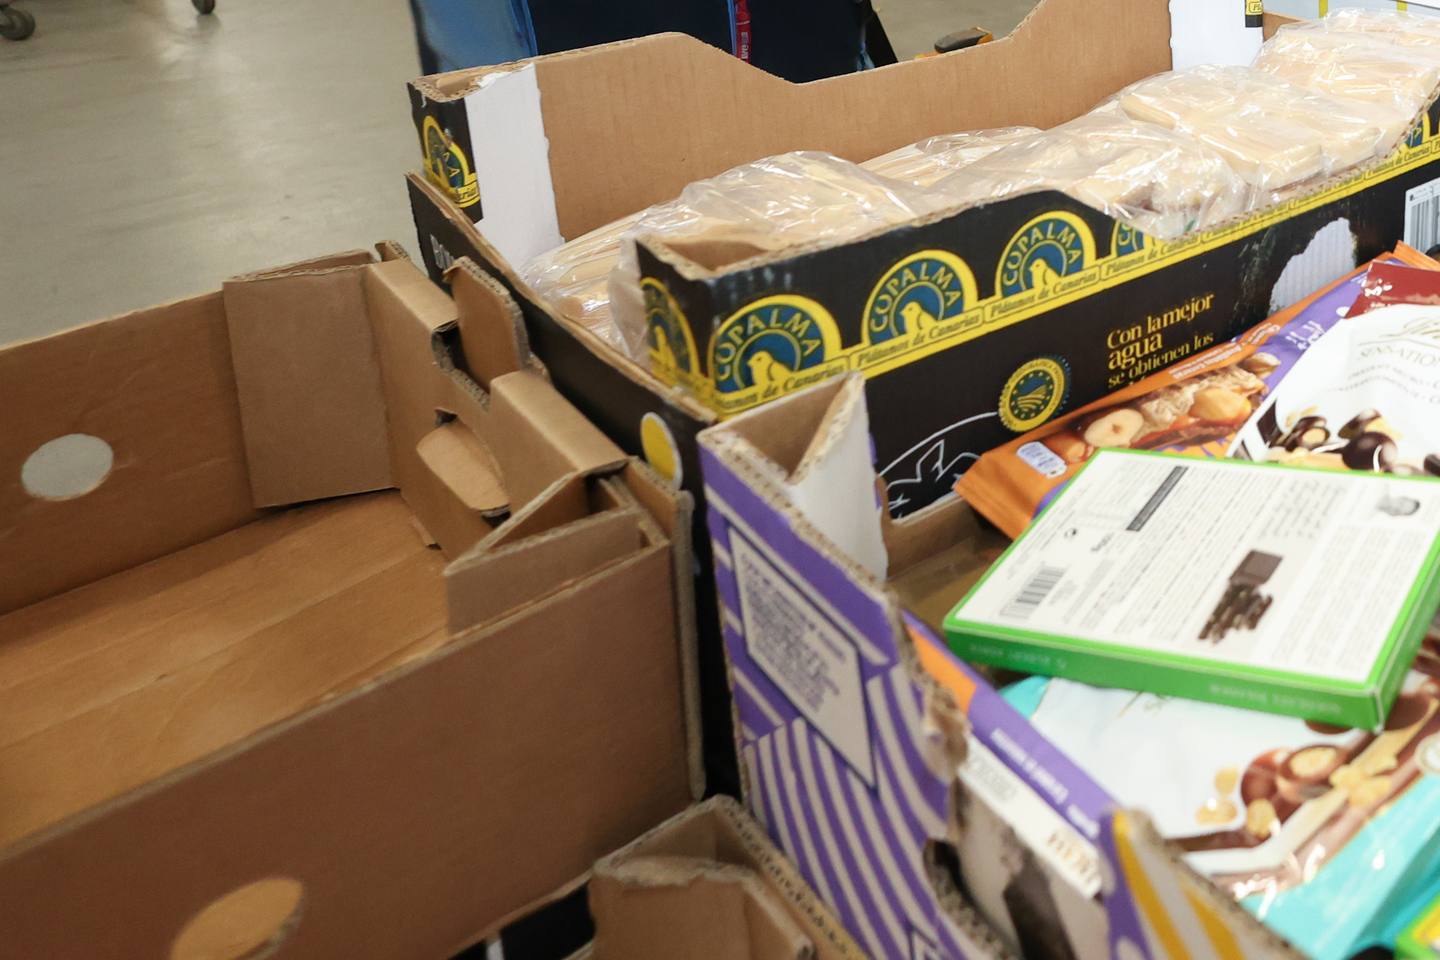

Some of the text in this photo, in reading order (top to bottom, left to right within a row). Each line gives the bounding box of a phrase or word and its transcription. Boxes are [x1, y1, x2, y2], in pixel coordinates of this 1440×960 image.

[1002, 221, 1082, 287] COPALMA
[870, 262, 962, 333] COPALMA
[1038, 286, 1050, 300] de
[1053, 271, 1097, 295] Canarias
[715, 308, 822, 382] COPALMA
[857, 313, 981, 367] Plátanos de Canarias
[1107, 323, 1142, 349] Con
[1108, 332, 1164, 370] agua
[1108, 332, 1214, 387] se obtienen los
